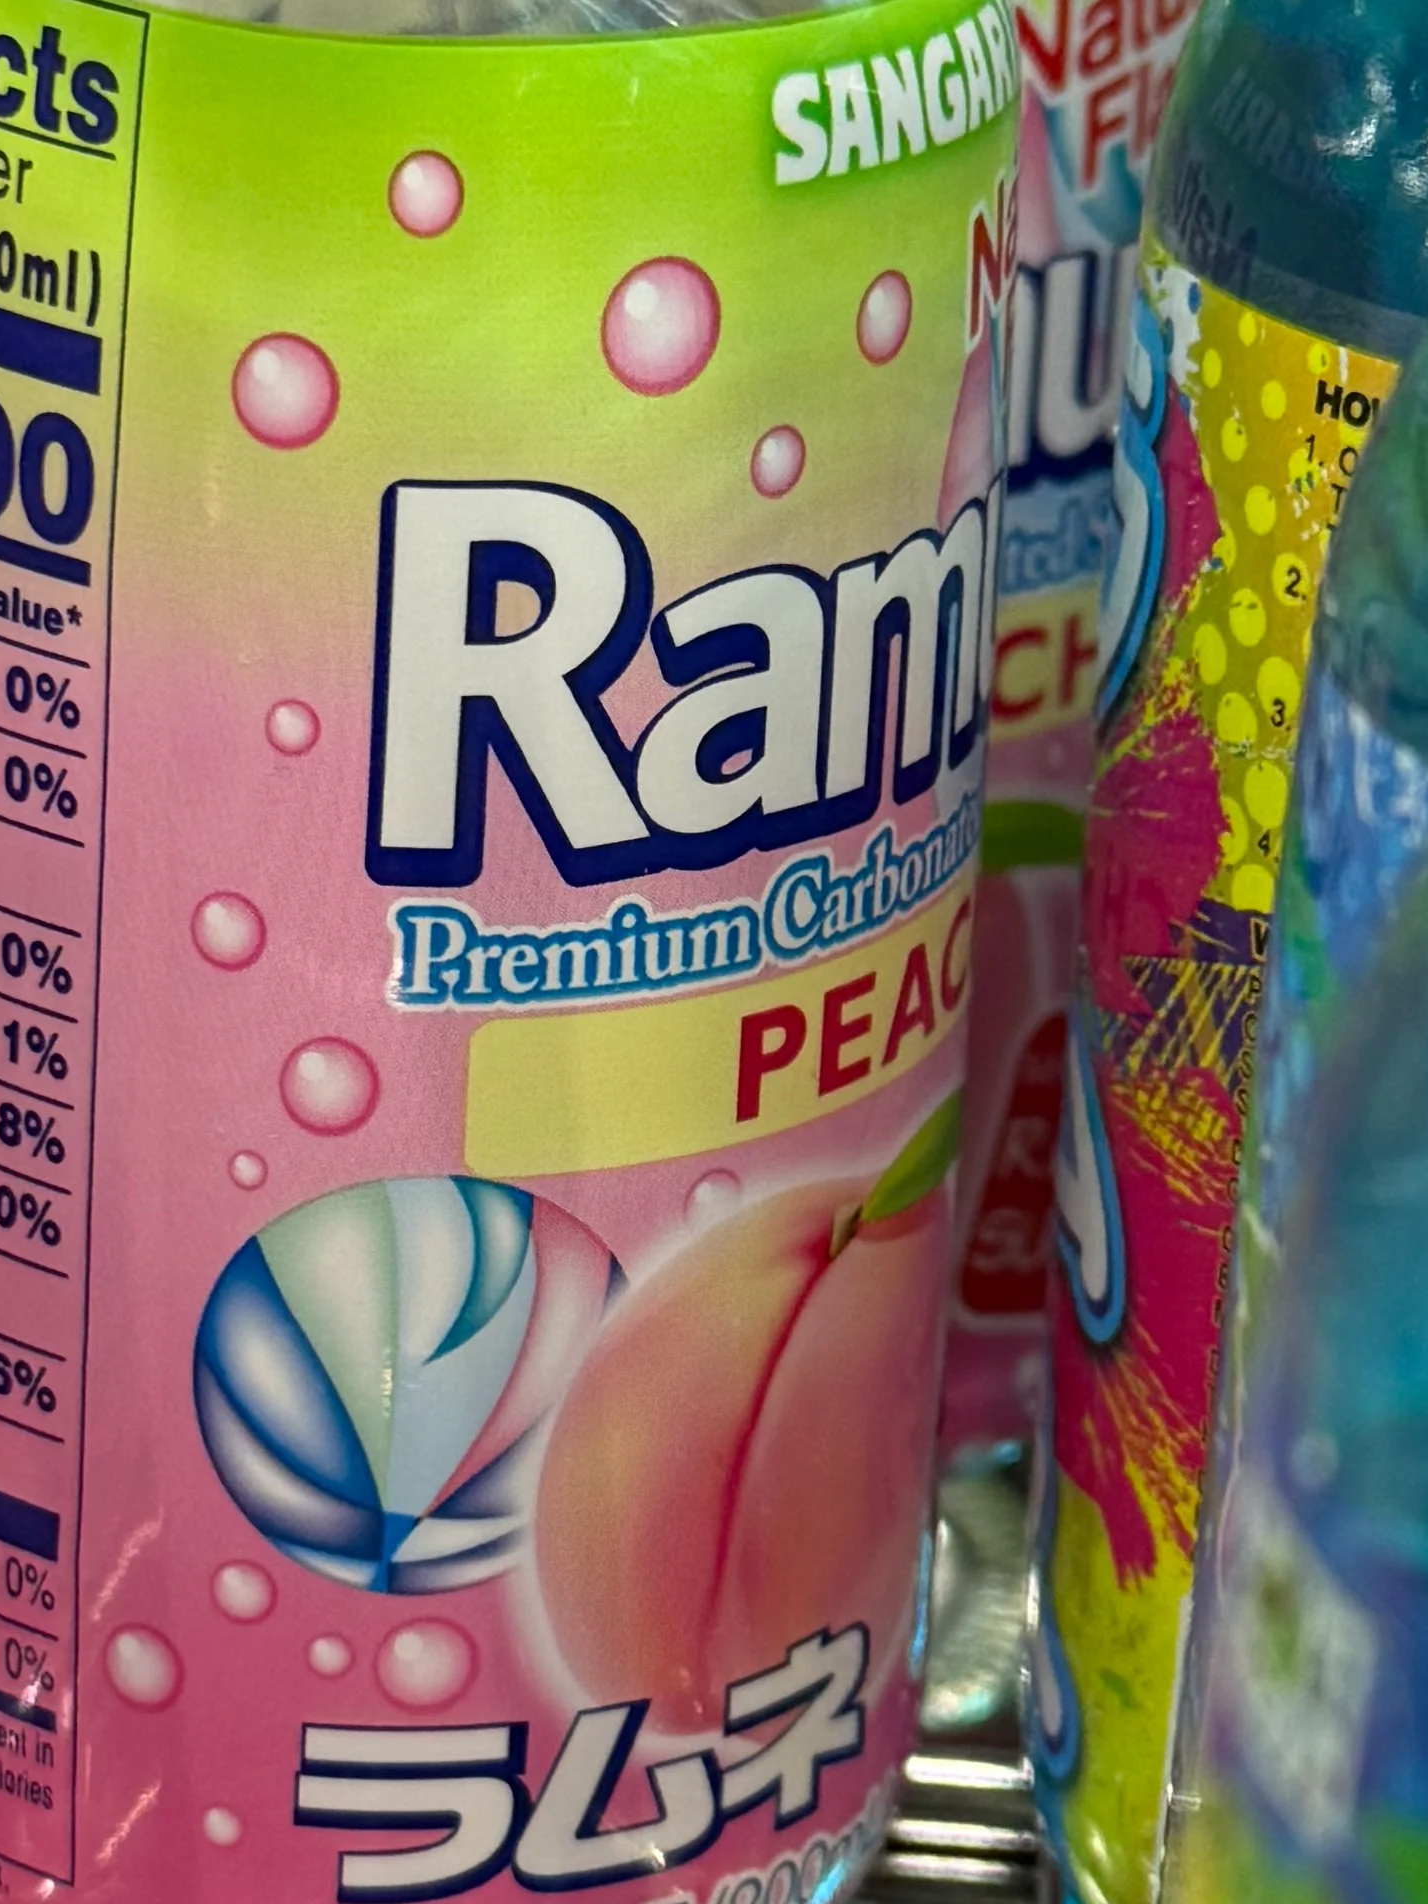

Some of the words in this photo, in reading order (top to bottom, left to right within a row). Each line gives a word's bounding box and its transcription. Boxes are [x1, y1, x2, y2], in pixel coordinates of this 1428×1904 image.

[5, 664, 82, 729] 0%
[3, 754, 79, 819] 0%
[0, 931, 73, 995] 0%
[400, 904, 760, 1001] Premium
[1, 1018, 69, 1080] 1%
[5, 1555, 56, 1613] 0%
[5, 1636, 56, 1693] 0%
[35, 1732, 55, 1769] in
